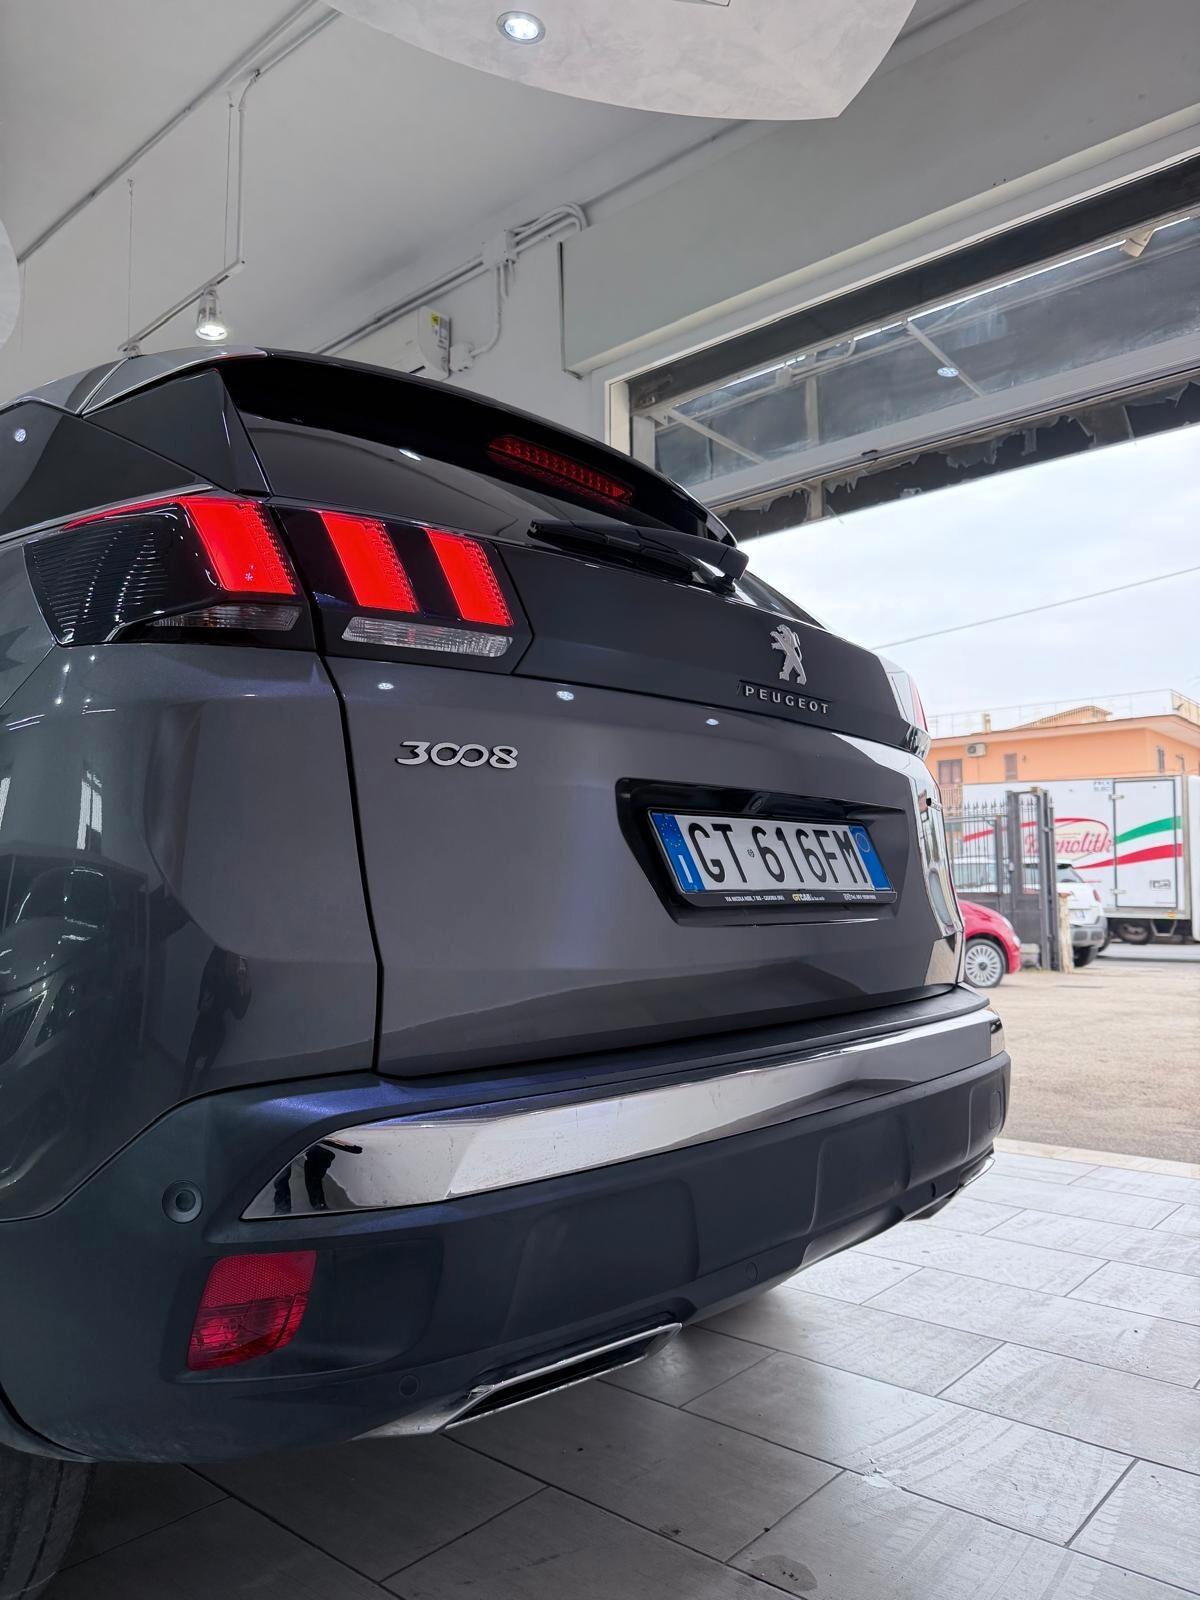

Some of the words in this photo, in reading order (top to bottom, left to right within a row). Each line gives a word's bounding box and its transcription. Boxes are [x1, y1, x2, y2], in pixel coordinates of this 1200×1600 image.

[744, 685, 829, 714] PEUGEOT
[396, 741, 519, 769] 3008
[688, 822, 748, 883] GT
[751, 825, 869, 883] 616FM
